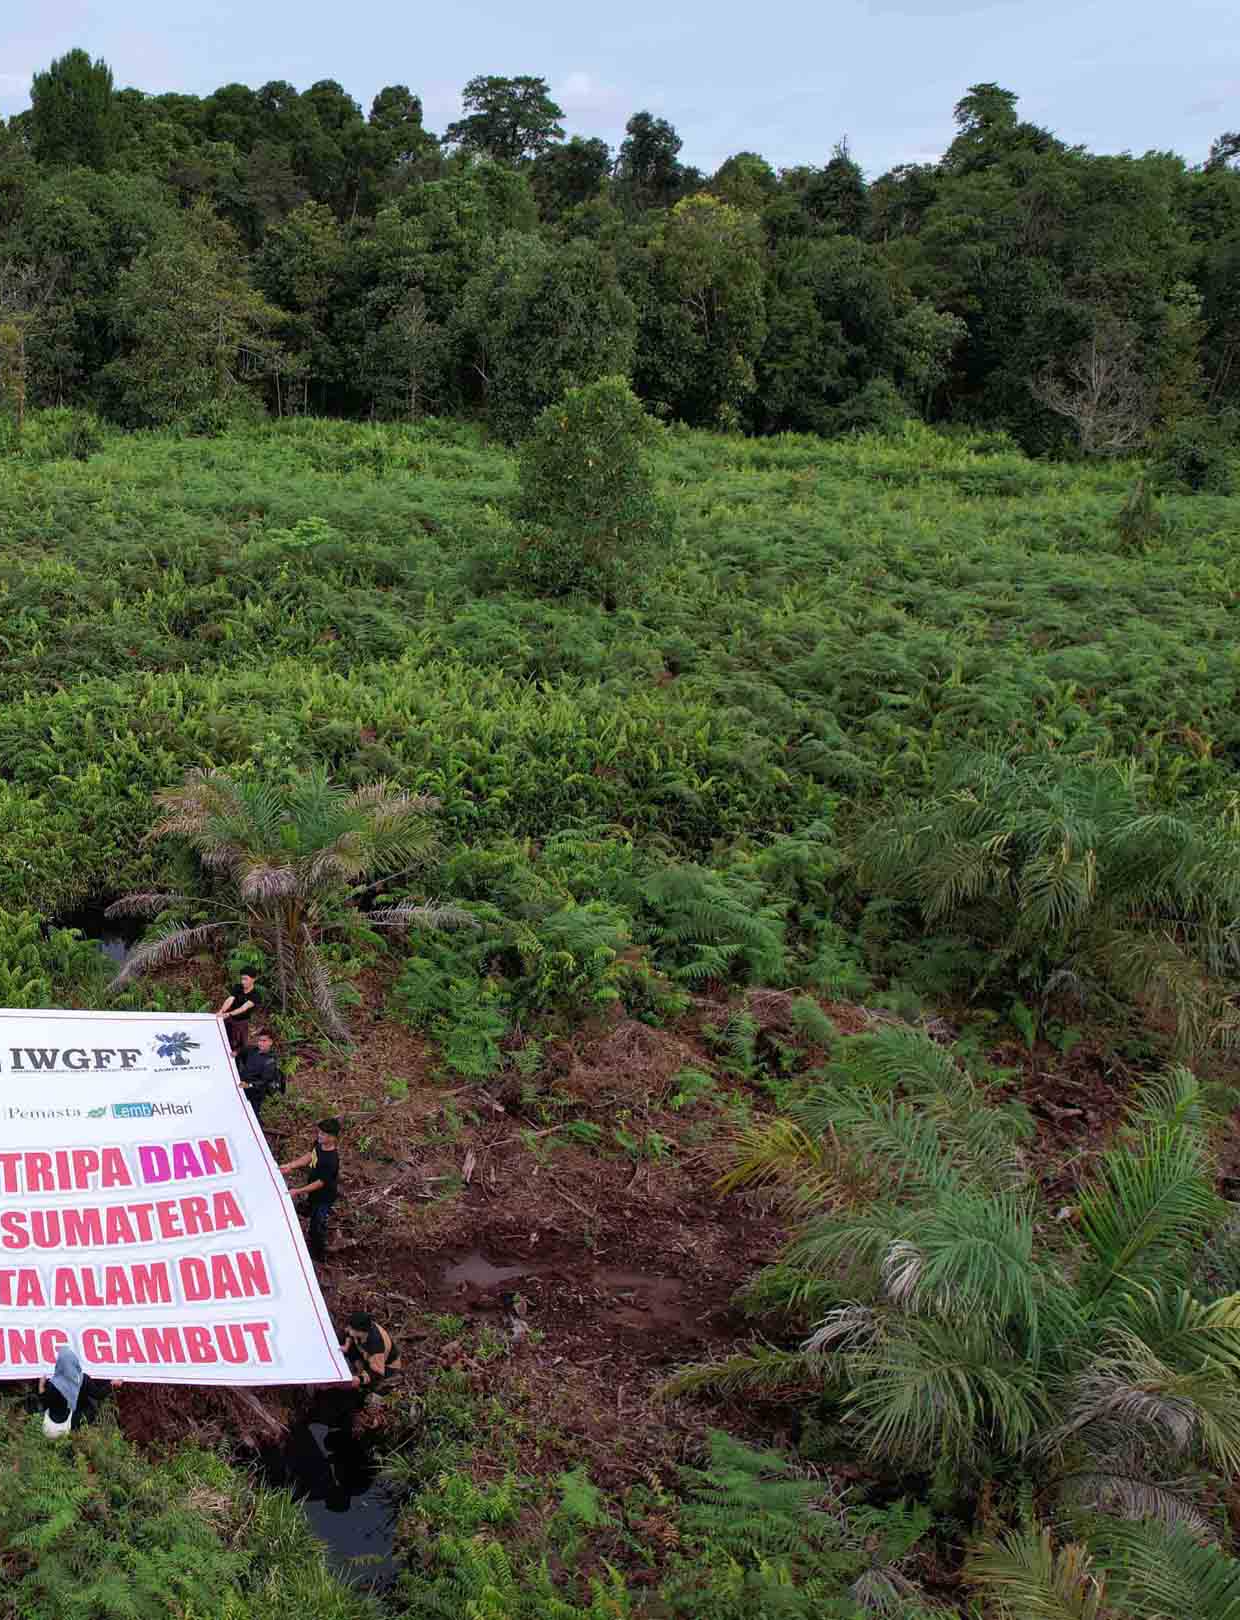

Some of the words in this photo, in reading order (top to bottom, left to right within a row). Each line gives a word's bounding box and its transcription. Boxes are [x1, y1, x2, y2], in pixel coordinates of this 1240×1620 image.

[10, 1048, 142, 1070] IWGFF
[138, 1138, 233, 1184] DAN
[0, 1191, 246, 1249] SUMATERA
[54, 1262, 172, 1306] ALAM
[179, 1250, 270, 1301] DAN
[82, 1322, 272, 1364] GAMBUT
